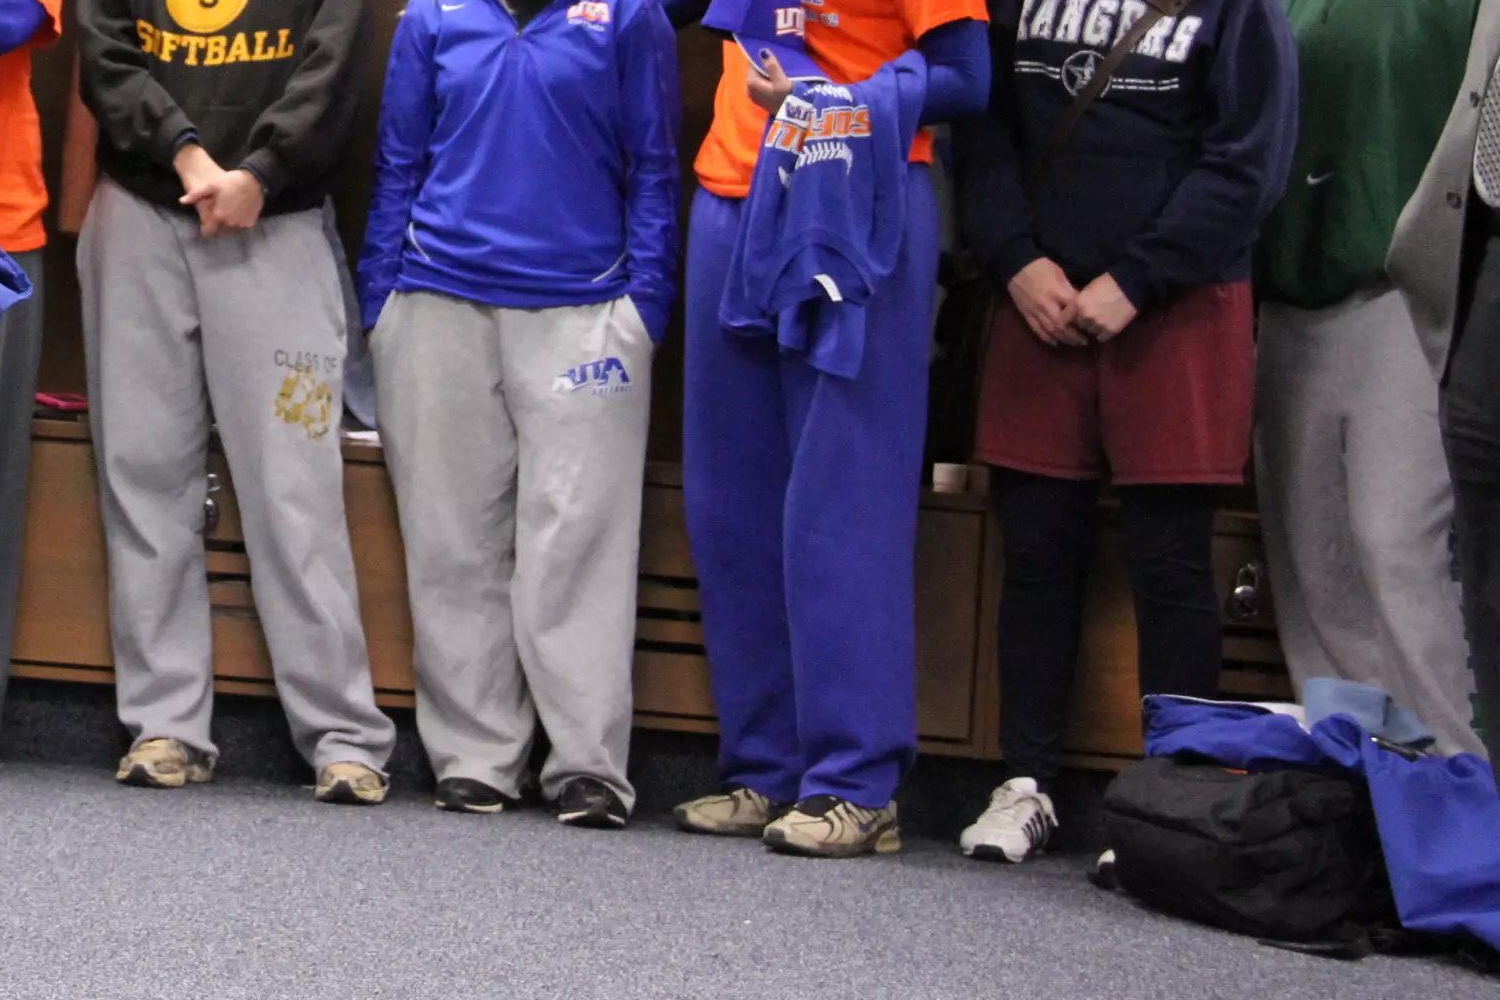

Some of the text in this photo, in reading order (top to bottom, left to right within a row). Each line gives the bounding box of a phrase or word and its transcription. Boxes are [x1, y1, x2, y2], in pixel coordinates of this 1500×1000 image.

[775, 7, 806, 37] UT
[136, 19, 295, 67] SFTBALL
[274, 349, 320, 372] CLASS
[567, 356, 630, 387] UTA
